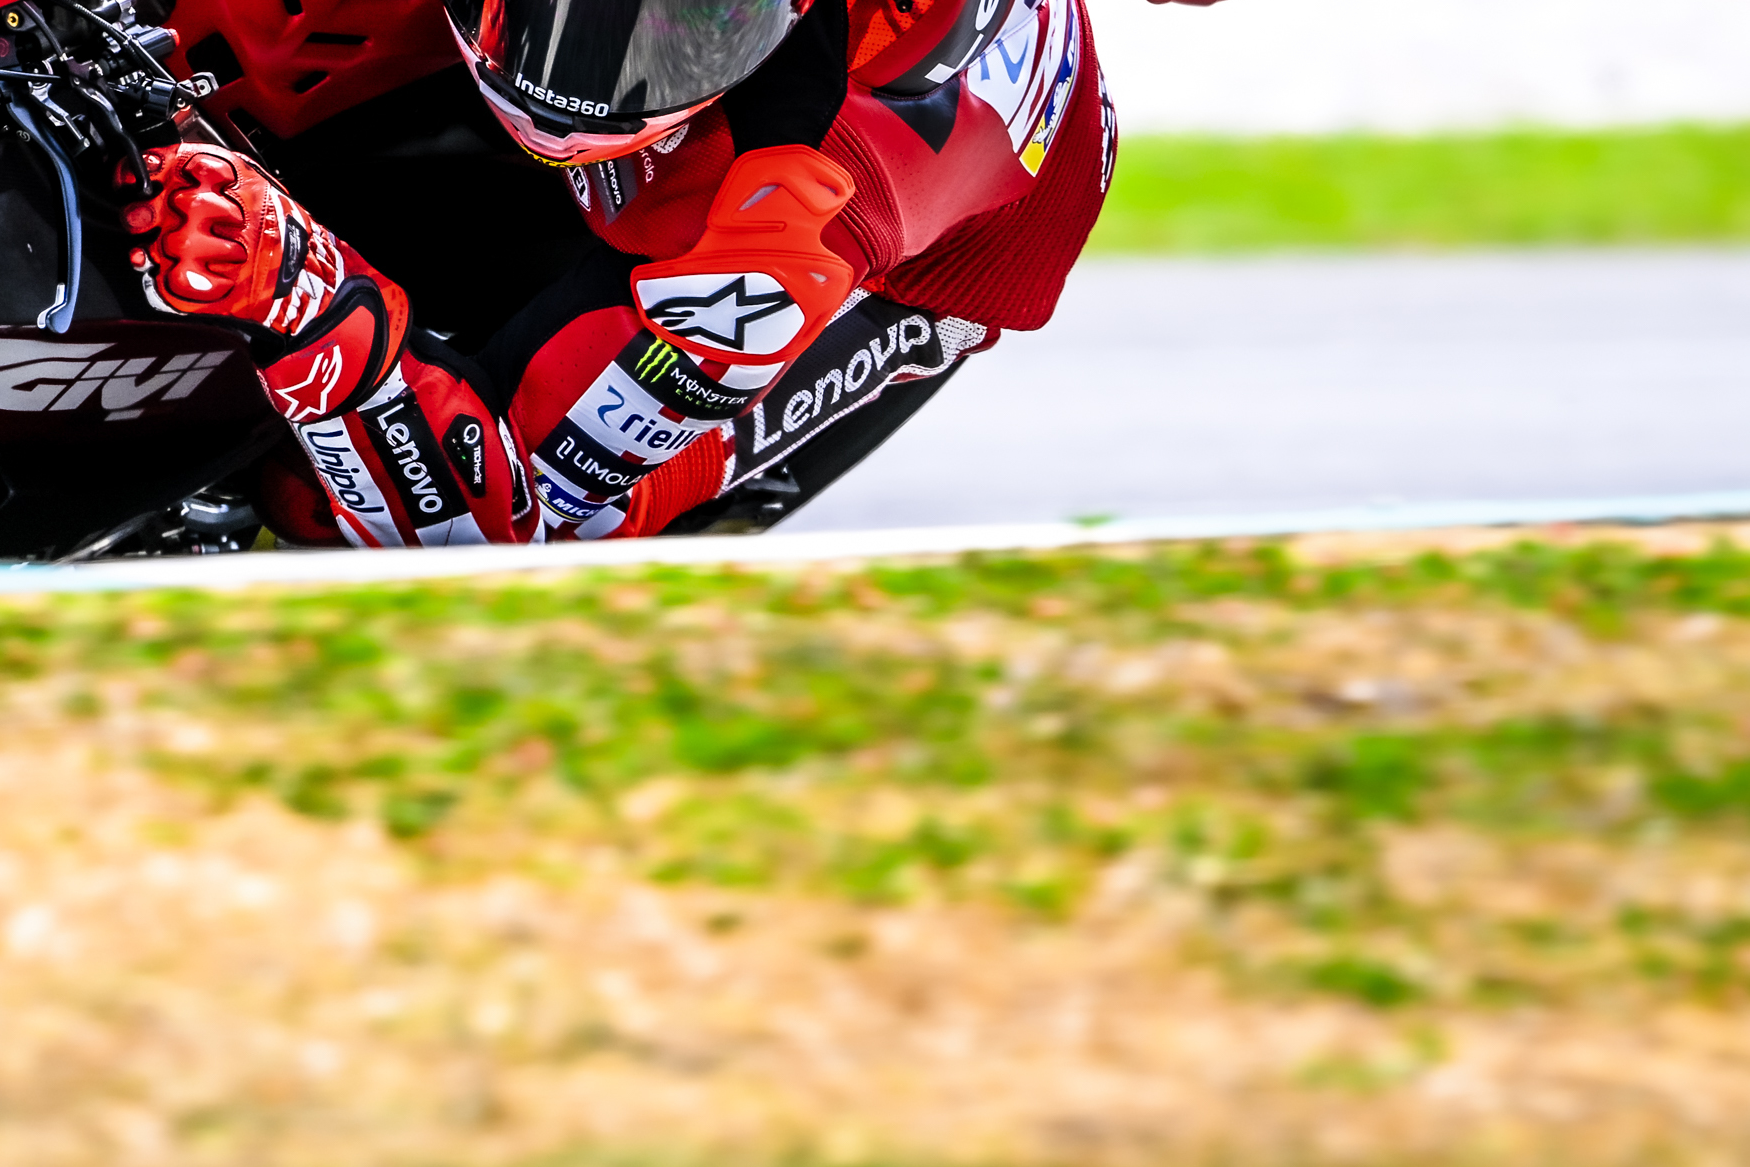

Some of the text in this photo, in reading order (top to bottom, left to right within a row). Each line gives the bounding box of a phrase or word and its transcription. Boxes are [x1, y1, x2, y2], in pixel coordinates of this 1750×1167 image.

[515, 72, 610, 117] Insta360
[753, 315, 932, 455] Lenovo
[303, 430, 385, 513] Unipol
[376, 403, 443, 513] Lenovo
